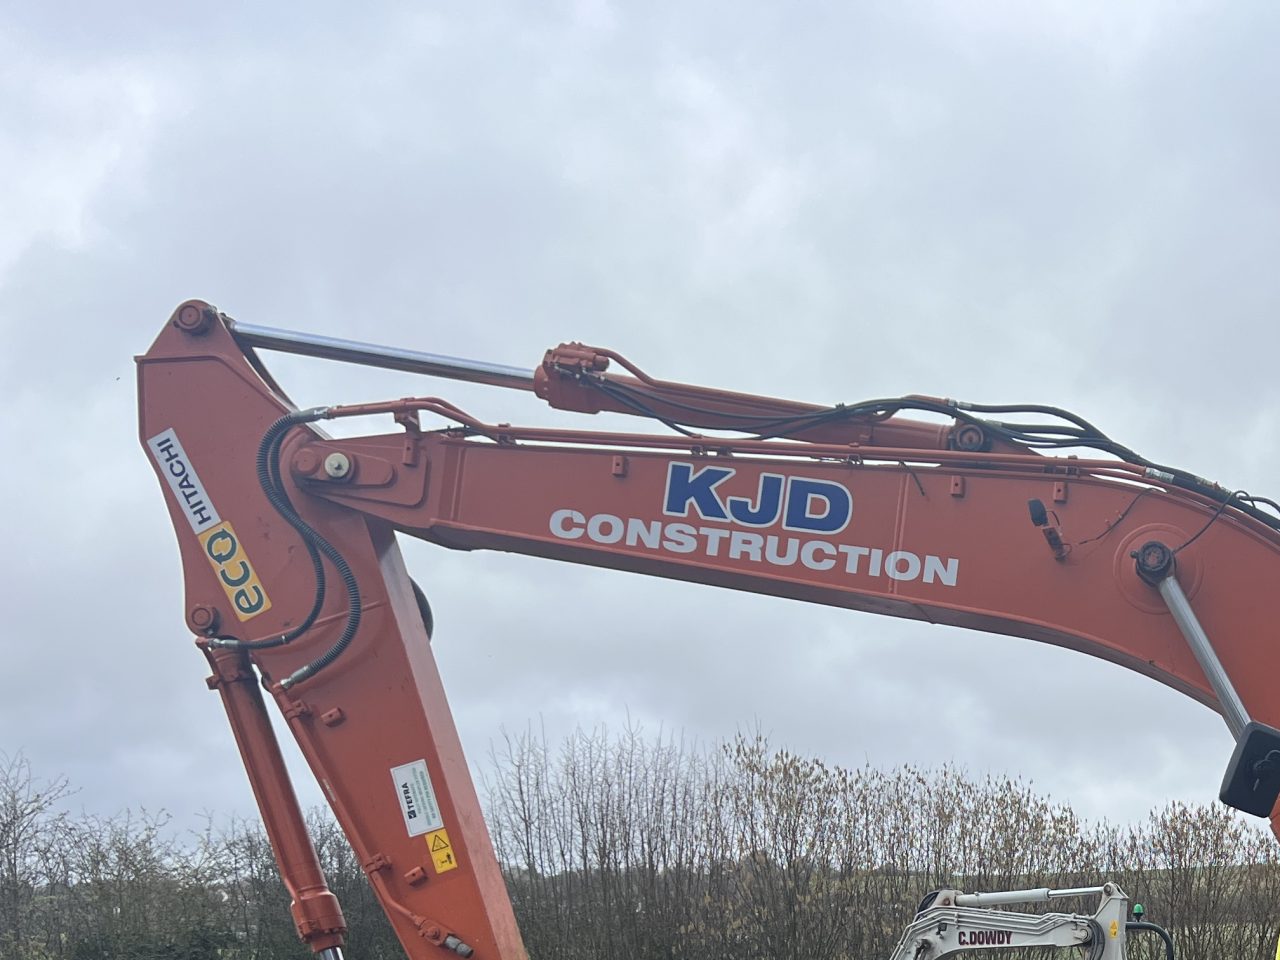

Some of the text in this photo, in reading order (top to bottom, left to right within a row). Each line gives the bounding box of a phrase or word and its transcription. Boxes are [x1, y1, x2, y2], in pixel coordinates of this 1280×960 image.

[156, 437, 212, 525] HITACHI
[663, 462, 853, 535] KJD
[206, 528, 264, 614] eco
[549, 508, 959, 587] CONSTRUCTION
[401, 782, 415, 811] TEFRA
